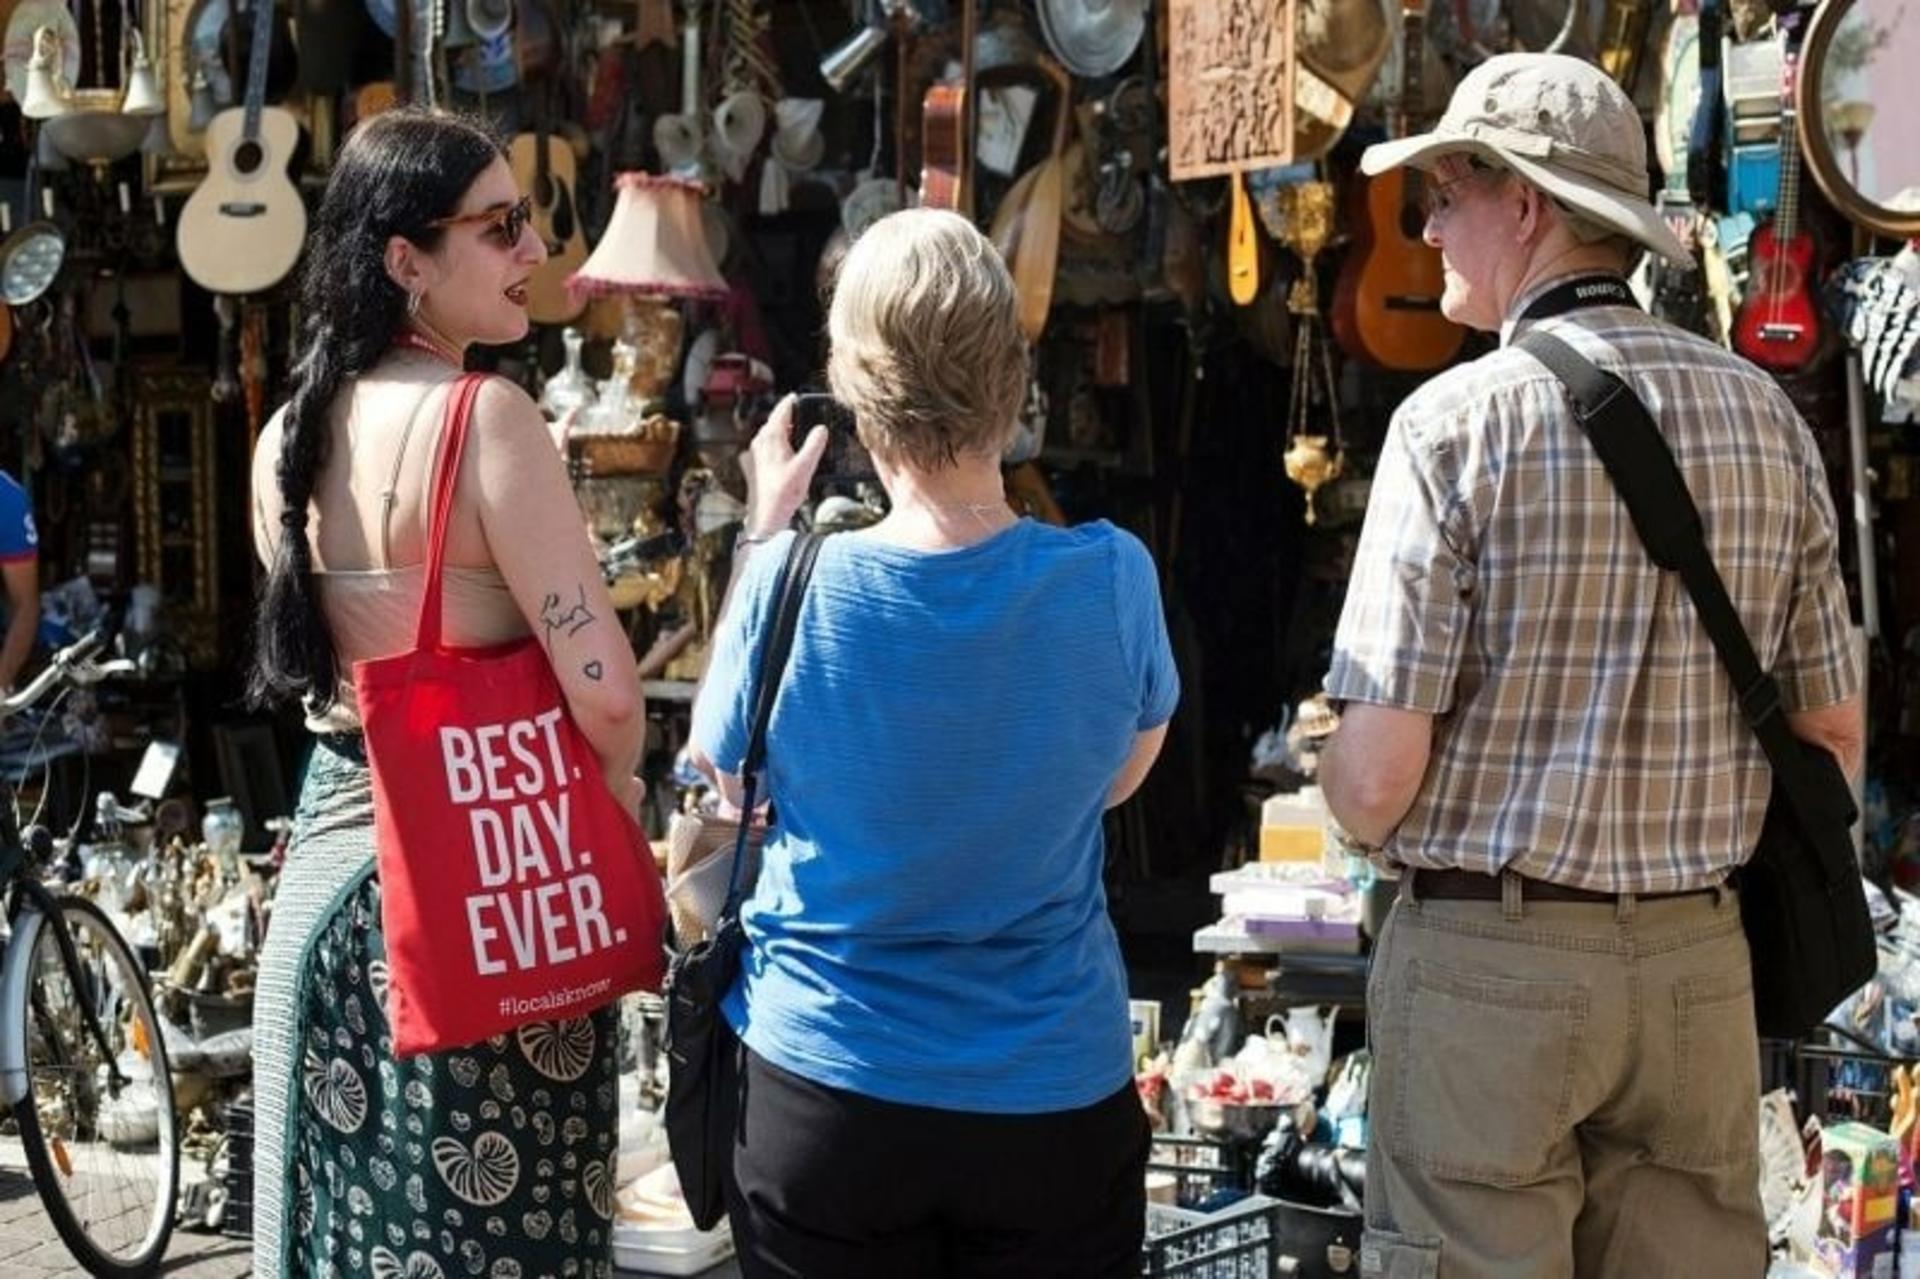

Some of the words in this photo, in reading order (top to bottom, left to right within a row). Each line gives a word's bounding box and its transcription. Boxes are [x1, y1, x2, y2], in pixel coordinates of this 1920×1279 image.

[440, 707, 581, 804] BEST.
[469, 793, 592, 888] DAY.
[466, 873, 627, 975] EVER.
[498, 978, 611, 1016] #localsknow
